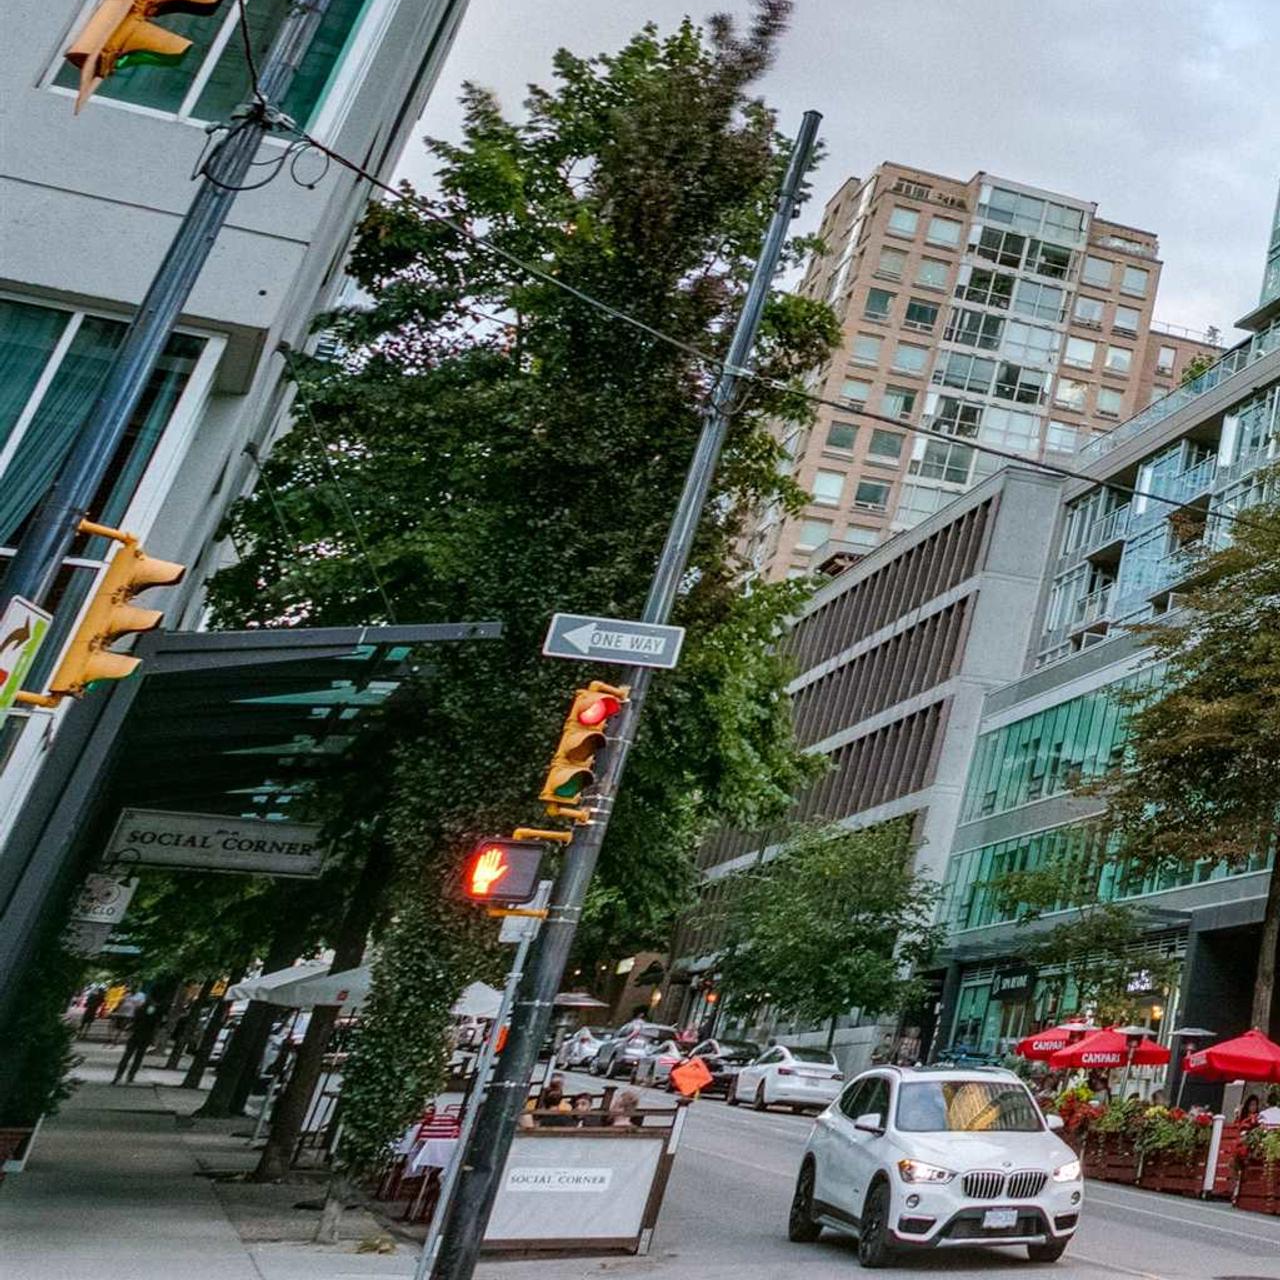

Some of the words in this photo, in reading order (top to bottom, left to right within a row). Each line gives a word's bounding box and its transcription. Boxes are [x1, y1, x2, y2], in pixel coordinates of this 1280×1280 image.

[591, 631, 624, 648] ONE
[629, 636, 664, 652] WAY
[125, 830, 211, 849] SOCIAL
[222, 837, 314, 856] CORNER
[1081, 1053, 1120, 1064] CAMPARI
[511, 1175, 552, 1185] SOCIAL
[558, 1175, 607, 1185] CORNER
